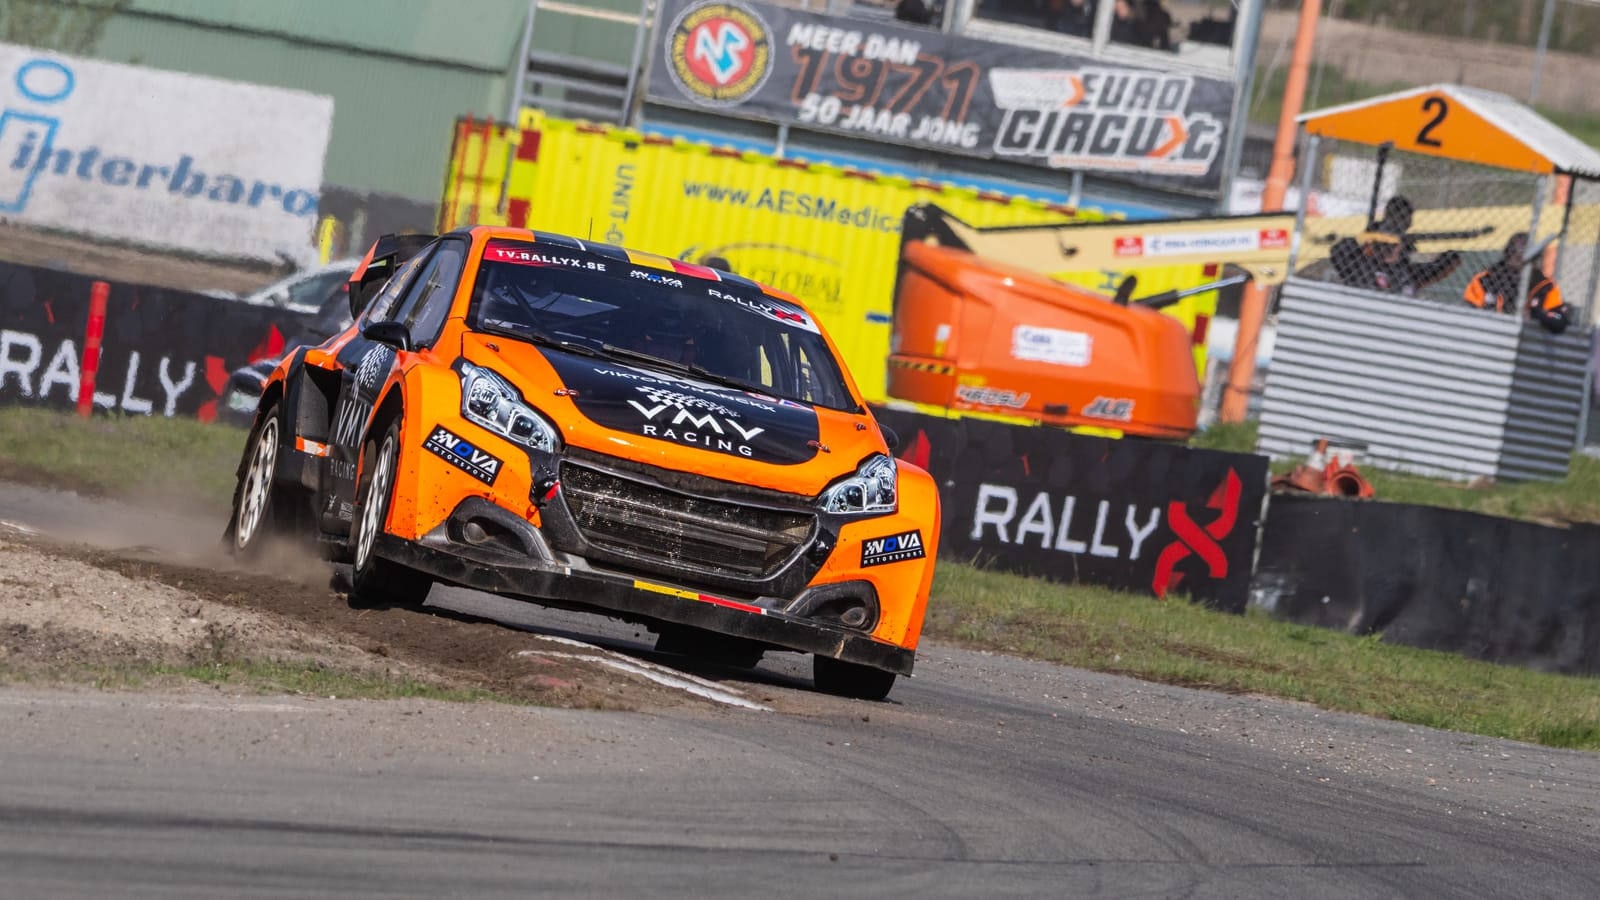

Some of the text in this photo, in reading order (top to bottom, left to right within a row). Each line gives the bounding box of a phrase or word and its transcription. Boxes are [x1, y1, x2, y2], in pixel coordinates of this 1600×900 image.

[787, 23, 921, 66] MEER DAN
[791, 43, 981, 126] 1971
[798, 92, 981, 149] 50 JAAR JONG
[1414, 96, 1449, 147] 2
[496, 249, 607, 272] TV.RALLYX.SE
[593, 368, 671, 386] VIKTOR
[627, 399, 765, 441] VMV
[643, 424, 753, 456] RACING
[426, 441, 492, 482] MOTORSPORT
[432, 430, 498, 475] NOVA
[864, 533, 921, 556] NOVA
